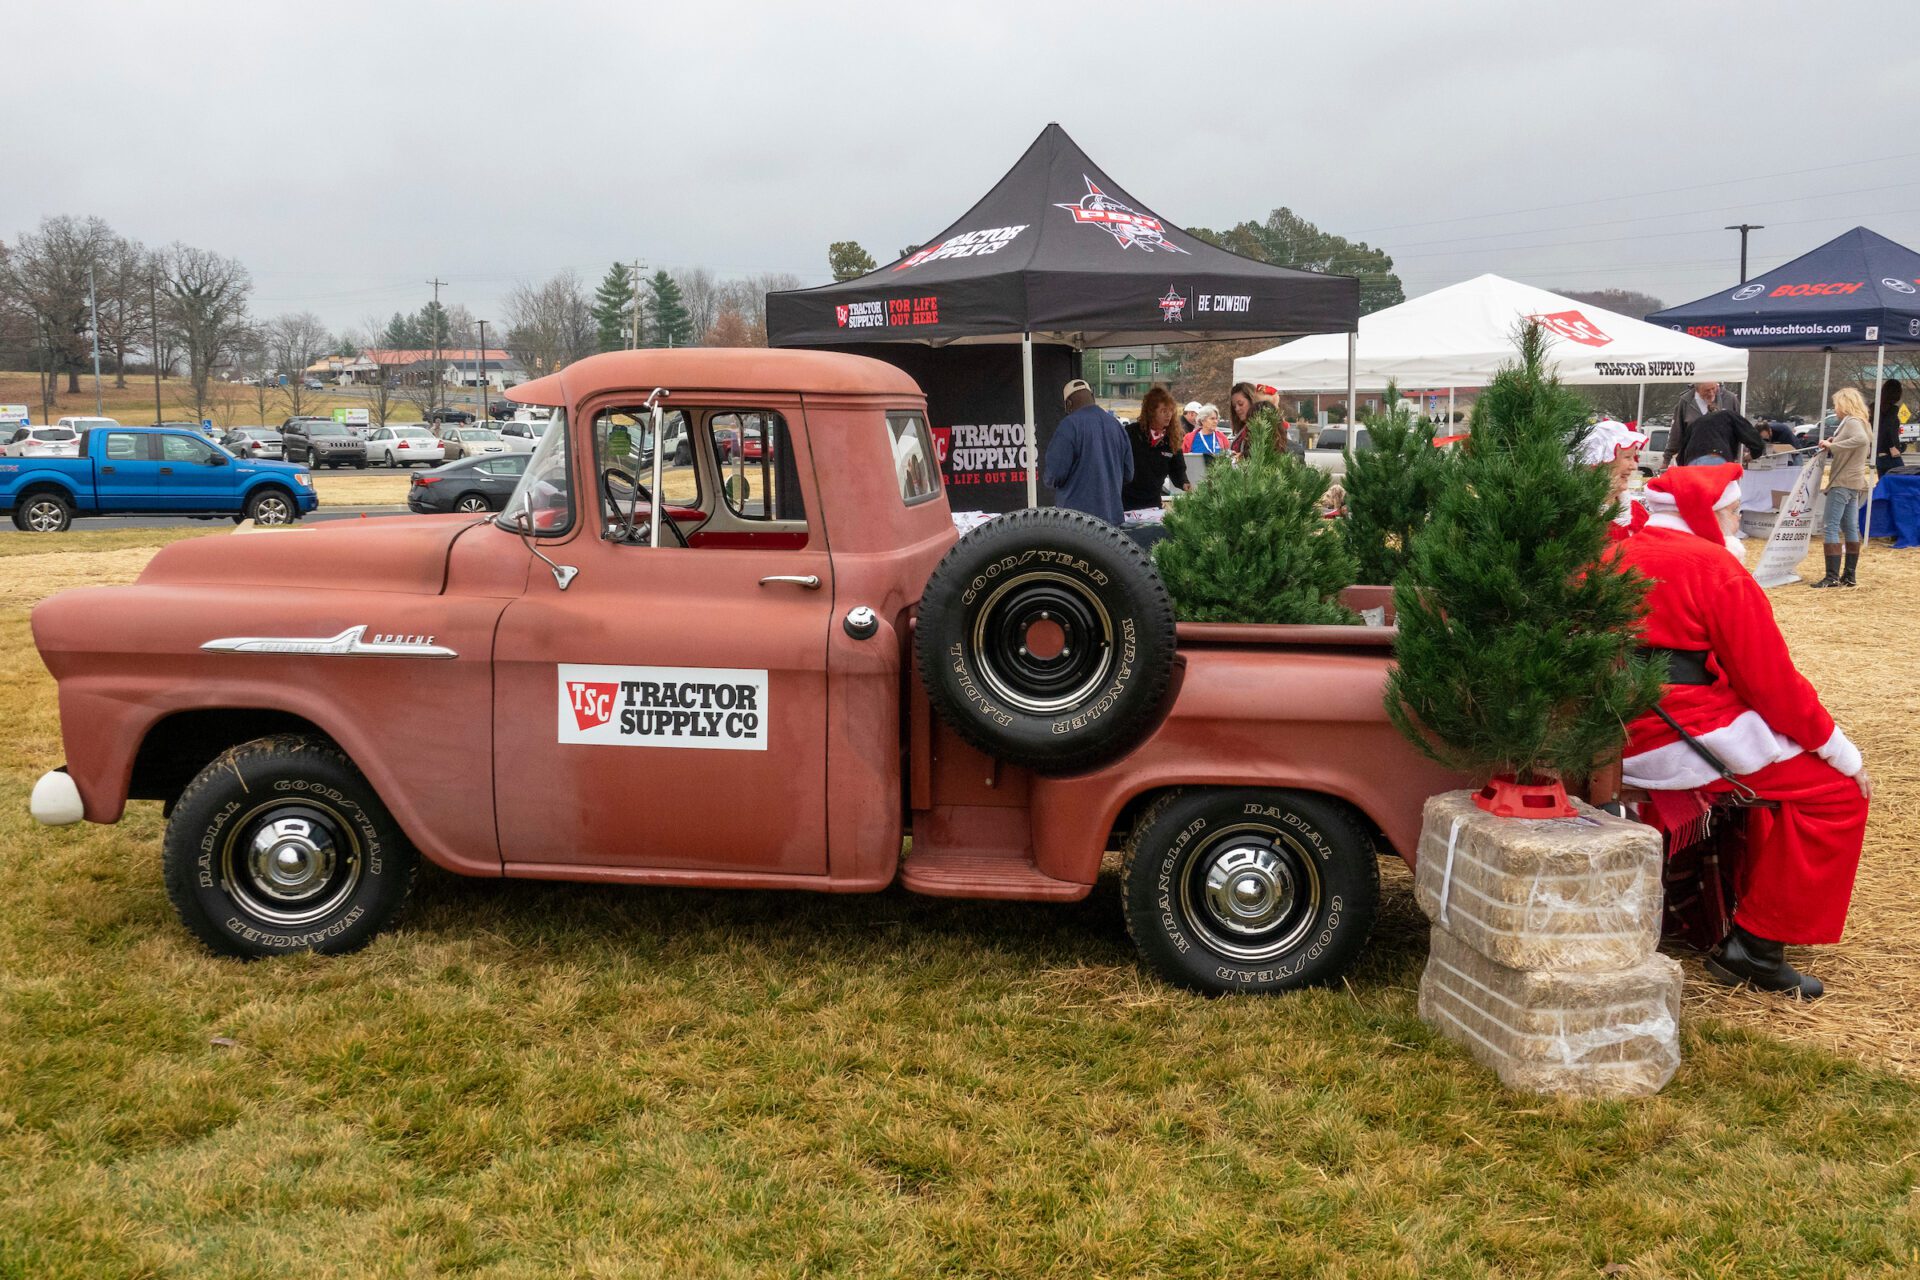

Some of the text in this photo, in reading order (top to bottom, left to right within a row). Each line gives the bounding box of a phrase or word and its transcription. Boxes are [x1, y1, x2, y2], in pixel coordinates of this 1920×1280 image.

[1079, 211, 1157, 228] PBR
[943, 225, 1027, 247] TRACTOR
[1768, 282, 1864, 298] BOSCH
[837, 305, 848, 323] TSC
[848, 301, 882, 316] TRACTOR
[889, 296, 938, 313] FOR LIFE
[1198, 294, 1251, 312] BE COWBOY
[849, 313, 876, 328] SUPPLY
[890, 311, 939, 327] OUT HERE
[1687, 323, 1851, 337] BOSCH www.boschtools.com
[1595, 362, 1647, 376] TRACTOR
[1649, 361, 1684, 376] SUPPLY
[952, 447, 1018, 471] SUPPLY
[954, 472, 980, 485] LIFE
[984, 471, 1006, 484] OUT
[1010, 470, 1039, 483] HE
[961, 550, 1109, 606] GOODYEAR
[372, 634, 435, 646] APACHE
[951, 642, 1013, 727] RADIAL
[1051, 618, 1136, 735] WRANGLER
[571, 683, 610, 722] TSC
[620, 681, 758, 711] TRACTOR
[620, 708, 723, 737] SUPPLY
[273, 780, 382, 875] GOODYEAR
[1243, 803, 1332, 860] RADIAL
[198, 801, 241, 888] RADIAL
[1158, 818, 1206, 954] WRANGLER
[226, 905, 364, 948] WRANGLER
[1216, 895, 1343, 983] GOODYEAR
